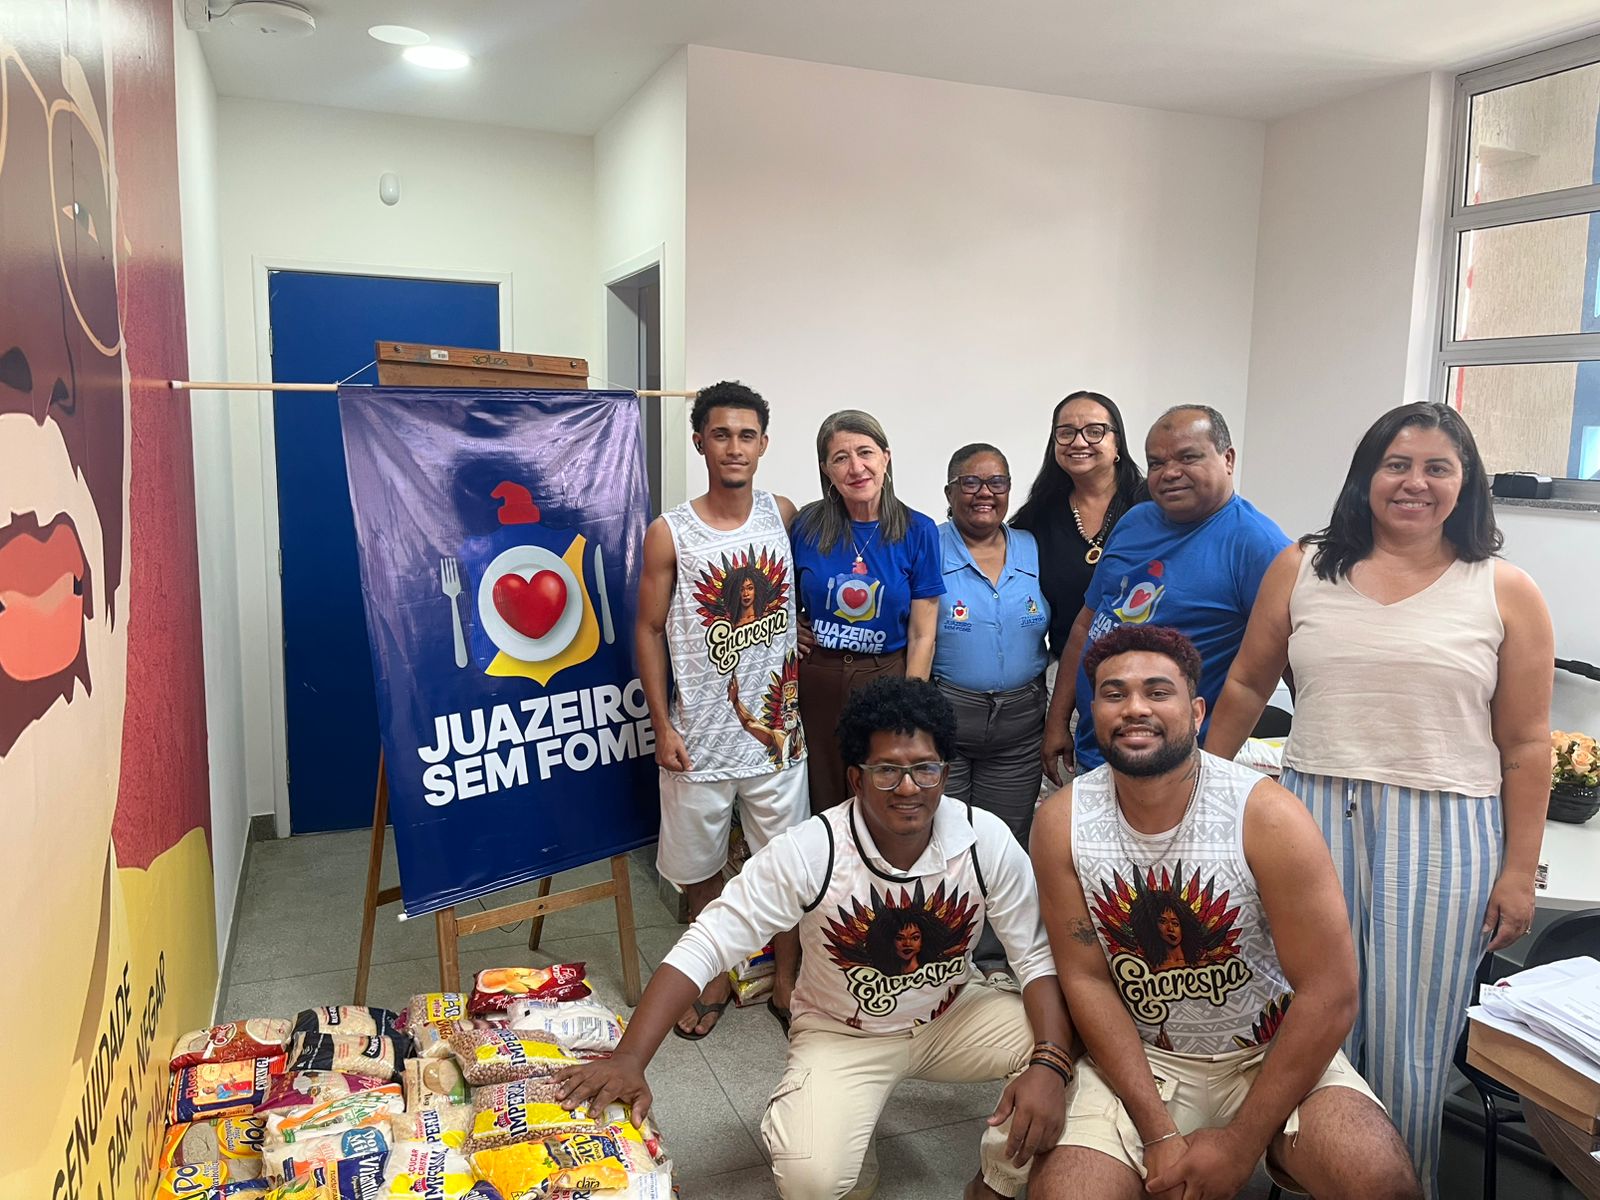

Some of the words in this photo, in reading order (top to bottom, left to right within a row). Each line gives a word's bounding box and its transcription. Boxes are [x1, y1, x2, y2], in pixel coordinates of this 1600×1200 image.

[706, 609, 788, 672] Encrespa
[811, 619, 887, 644] JUAZEIRO
[839, 638, 884, 655] FOME
[418, 678, 650, 763] JUAZEIRO
[422, 746, 528, 806] SEM
[536, 718, 656, 780] FOME
[848, 957, 965, 1016] Encrespa
[1112, 955, 1251, 1022] Encrespa
[136, 951, 167, 1091] NEGAR
[510, 1080, 528, 1138] IMPERIA
[418, 1152, 428, 1176] CRISTAL
[576, 1177, 601, 1189] clara
